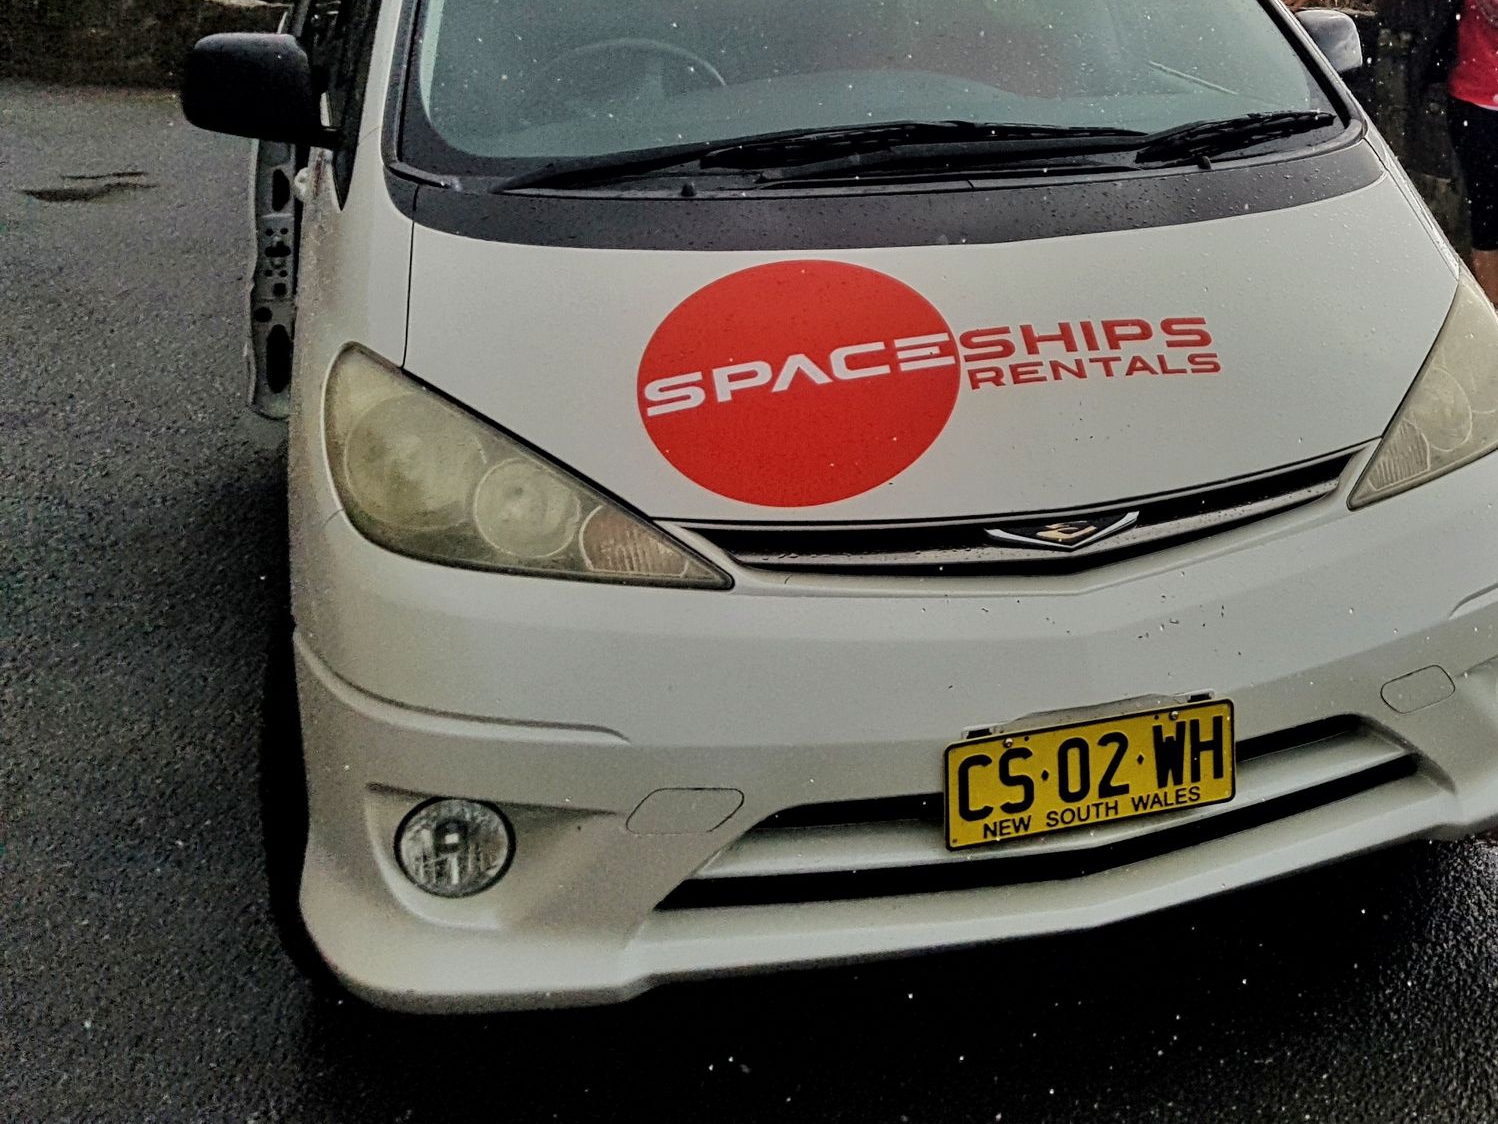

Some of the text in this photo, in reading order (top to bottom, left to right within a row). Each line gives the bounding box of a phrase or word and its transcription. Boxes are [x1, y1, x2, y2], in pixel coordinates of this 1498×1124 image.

[966, 352, 1222, 390] RENTALS
[982, 785, 1201, 840] NEW SOUTH WALES
